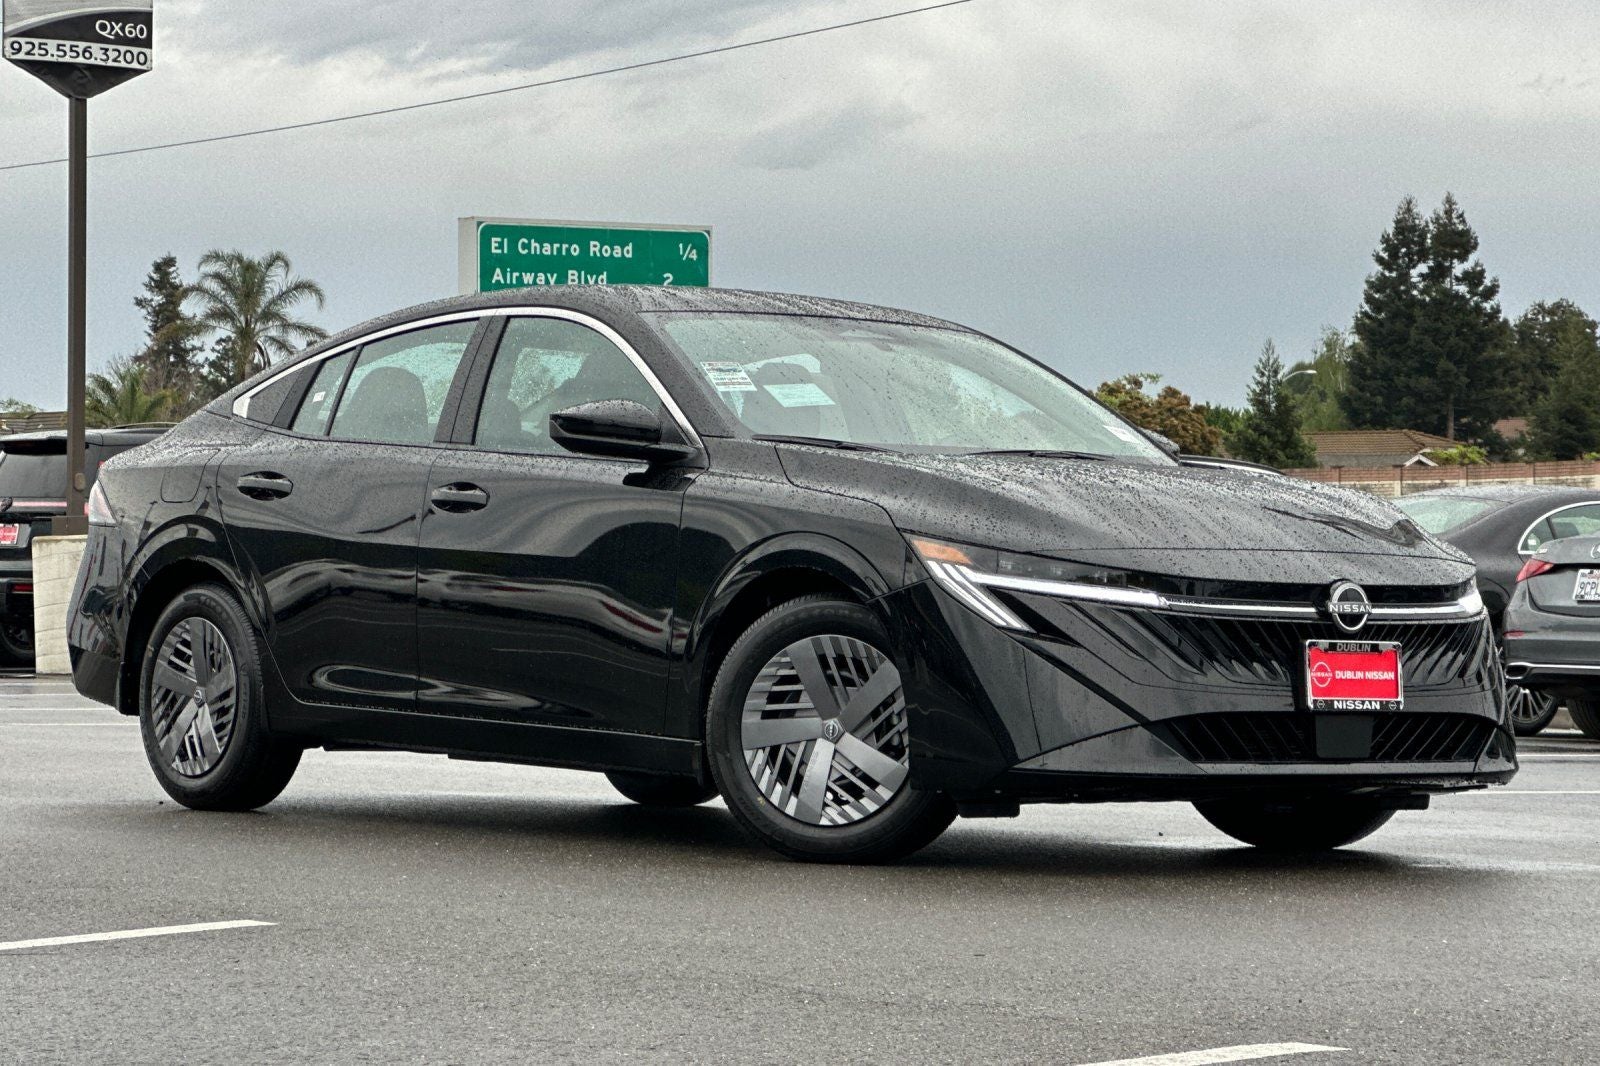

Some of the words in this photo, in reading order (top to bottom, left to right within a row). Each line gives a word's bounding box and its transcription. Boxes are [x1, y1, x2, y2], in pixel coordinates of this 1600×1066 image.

[95, 19, 147, 39] QX60
[10, 40, 148, 66] 925.556.3200
[491, 237, 508, 254] El
[518, 238, 580, 257] Charro
[589, 240, 633, 258] Road
[491, 267, 558, 285] Airway
[567, 269, 608, 285] Blvd
[1329, 604, 1372, 613] NISSAN
[1336, 643, 1372, 652] DUBLIN
[1335, 670, 1364, 680] DUBLIN
[1365, 671, 1395, 680] NISSAN
[1333, 700, 1381, 710] NISSAN
